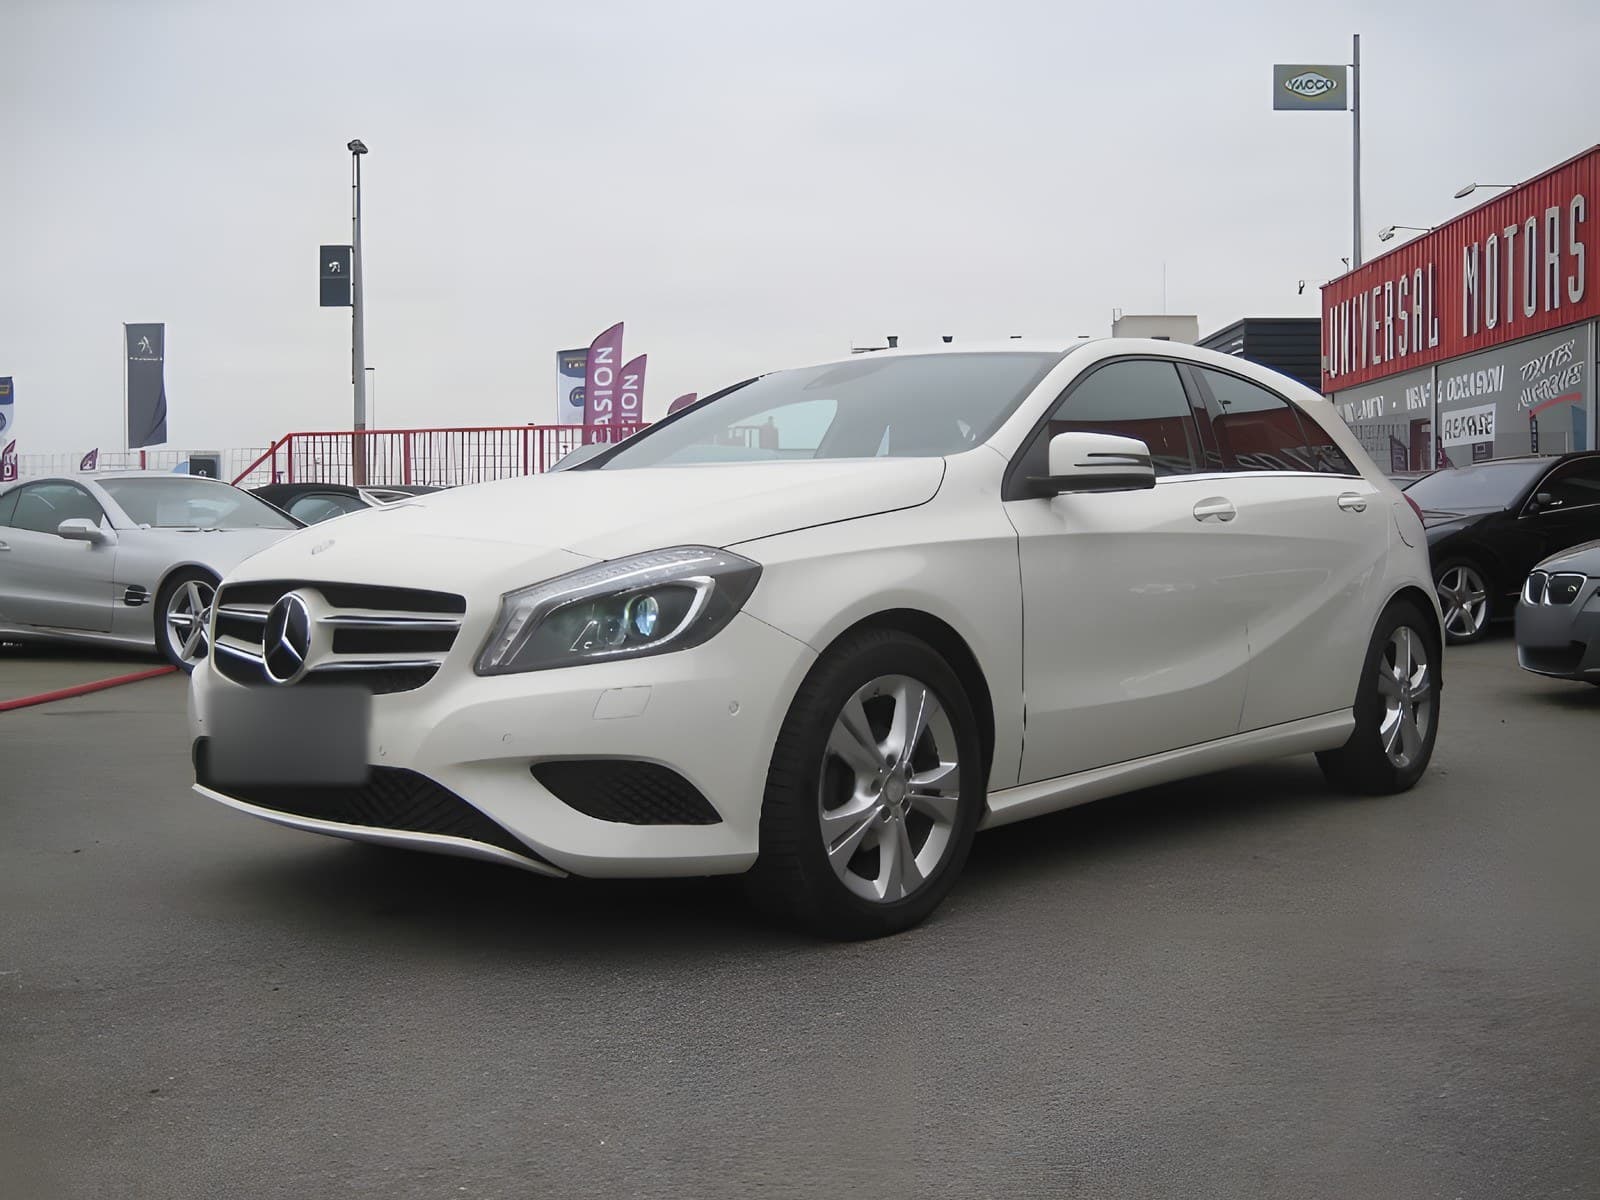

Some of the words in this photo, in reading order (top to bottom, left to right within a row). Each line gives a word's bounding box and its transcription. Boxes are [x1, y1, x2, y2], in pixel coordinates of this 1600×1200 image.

[1287, 79, 1334, 90] YACCO
[1329, 262, 1439, 379] UNIVERSAL
[1462, 193, 1586, 338] MOTORS
